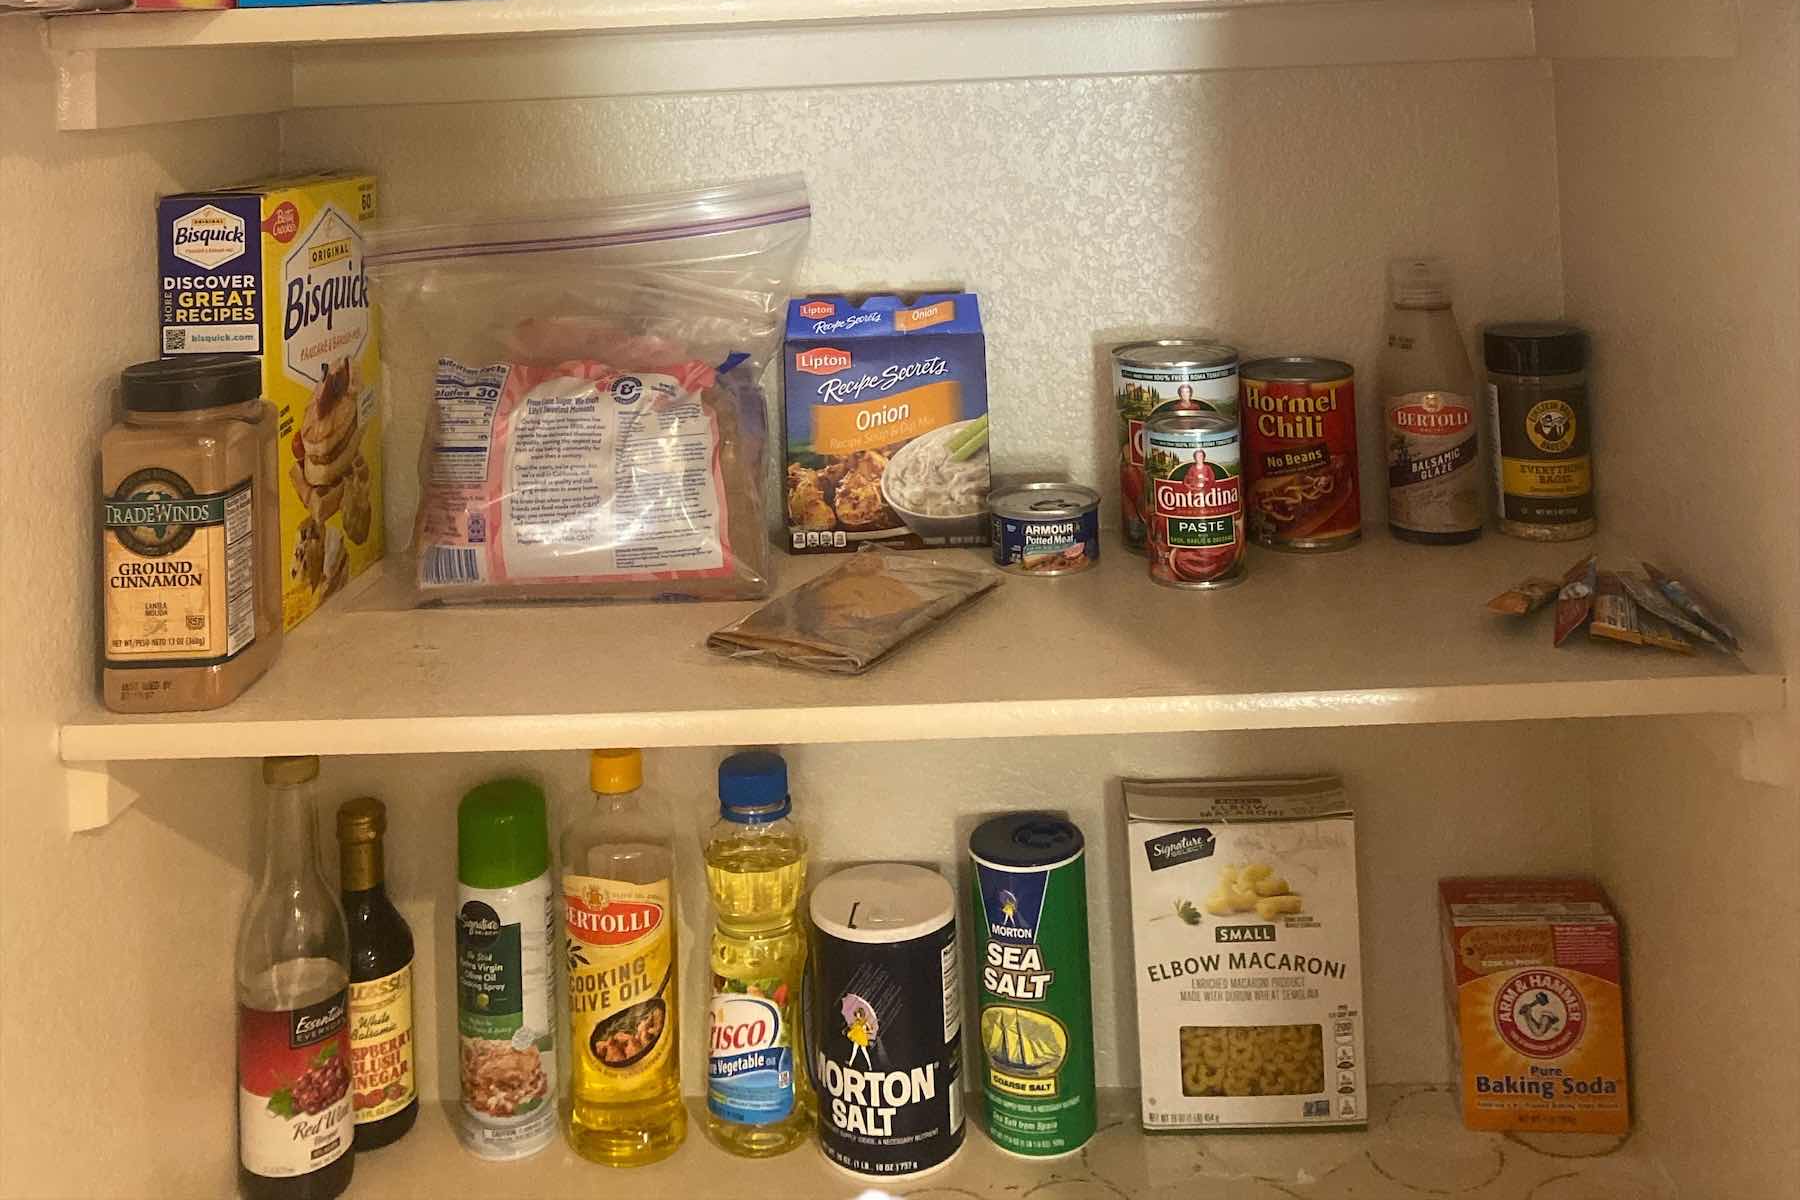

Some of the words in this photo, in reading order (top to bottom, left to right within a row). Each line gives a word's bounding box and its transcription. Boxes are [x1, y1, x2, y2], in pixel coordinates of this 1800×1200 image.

[175, 226, 244, 246] Bisquick
[312, 245, 348, 262] ORIGINAL
[164, 275, 255, 290] DISCOVER
[165, 292, 173, 322] MORE
[179, 290, 256, 308] GREAT
[284, 260, 369, 341] Bisquick
[176, 308, 255, 323] RECIPES
[802, 306, 833, 314] Lipton
[912, 306, 938, 321] Onion
[813, 320, 847, 335] Recipe
[846, 312, 881, 329] Secrets
[191, 332, 254, 343] bisquick.com
[801, 356, 847, 369] Lipton
[817, 375, 884, 403] Recipe
[881, 356, 949, 391] Secrets
[1248, 385, 1336, 413] Hormel
[856, 403, 910, 431] Onion
[1397, 411, 1468, 427] BERTOLLI
[1258, 414, 1323, 438] Chili
[1267, 456, 1283, 467] No
[1285, 450, 1322, 466] Beans
[1412, 448, 1460, 473] BALSAMIC
[1421, 462, 1452, 480] GLAZE
[1158, 486, 1238, 511] Contadina
[1025, 524, 1073, 535] ARMOUR
[1179, 521, 1225, 532] PASTE
[1026, 535, 1051, 545] Potted
[1054, 535, 1074, 545] Meat
[119, 562, 193, 576] GROUND
[110, 573, 202, 588] CINNAMON
[1153, 836, 1204, 858] Signature
[992, 924, 1032, 938] MORTON
[1220, 928, 1270, 941] SMALL
[987, 942, 1041, 971] SEA
[478, 963, 504, 974] Virgin
[569, 957, 646, 993] COOKING
[1147, 954, 1220, 982] ELBOW
[1228, 952, 1346, 979] MACARONI
[484, 974, 497, 982] Oil
[984, 970, 1051, 999] SALT
[1230, 978, 1269, 988] MACARONI
[483, 983, 505, 992] Spray
[620, 975, 652, 1001] OIL
[1180, 991, 1200, 1001] MADE
[1204, 991, 1223, 1001] WITH
[1500, 988, 1518, 1022] ARM
[1516, 980, 1528, 991] &
[1529, 975, 1581, 1022] HAMMER
[358, 1012, 390, 1028] White
[718, 1053, 764, 1076] Vegetable
[1530, 1066, 1562, 1076] Pure
[818, 1051, 936, 1108] MORTON
[993, 1075, 1027, 1091] COARSE
[1476, 1076, 1554, 1099] Baking
[1563, 1076, 1617, 1095] Soda
[832, 1098, 897, 1137] SALT
[293, 1115, 321, 1141] Red
